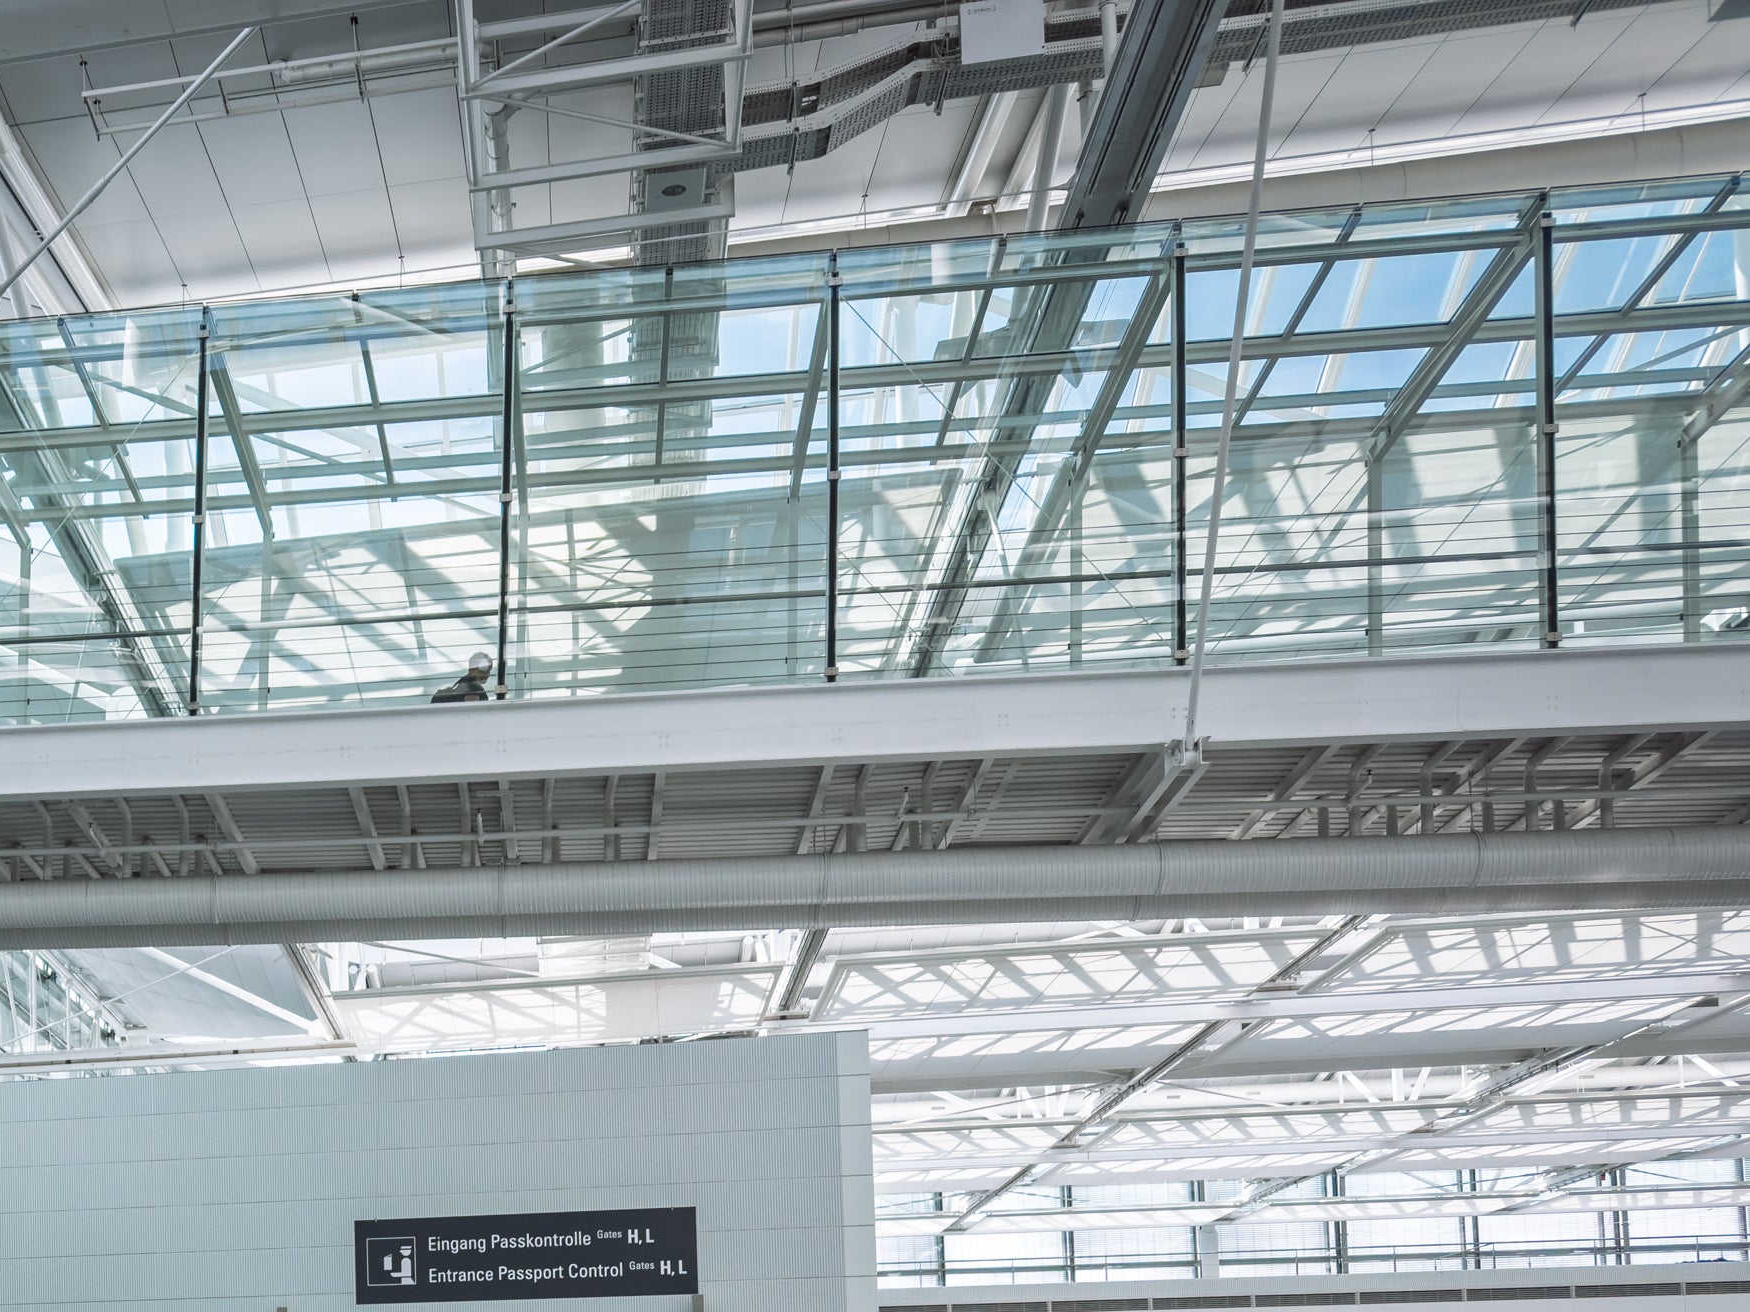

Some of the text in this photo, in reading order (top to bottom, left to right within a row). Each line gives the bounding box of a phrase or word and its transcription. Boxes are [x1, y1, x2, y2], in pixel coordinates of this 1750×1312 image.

[428, 1236, 486, 1254] Eingang
[491, 1231, 592, 1249] Passkontrolle
[596, 1230, 623, 1239] Gates
[428, 1268, 494, 1283] Entrance
[498, 1265, 564, 1283] Passport
[568, 1262, 624, 1279] Control
[629, 1261, 655, 1271] Gates
